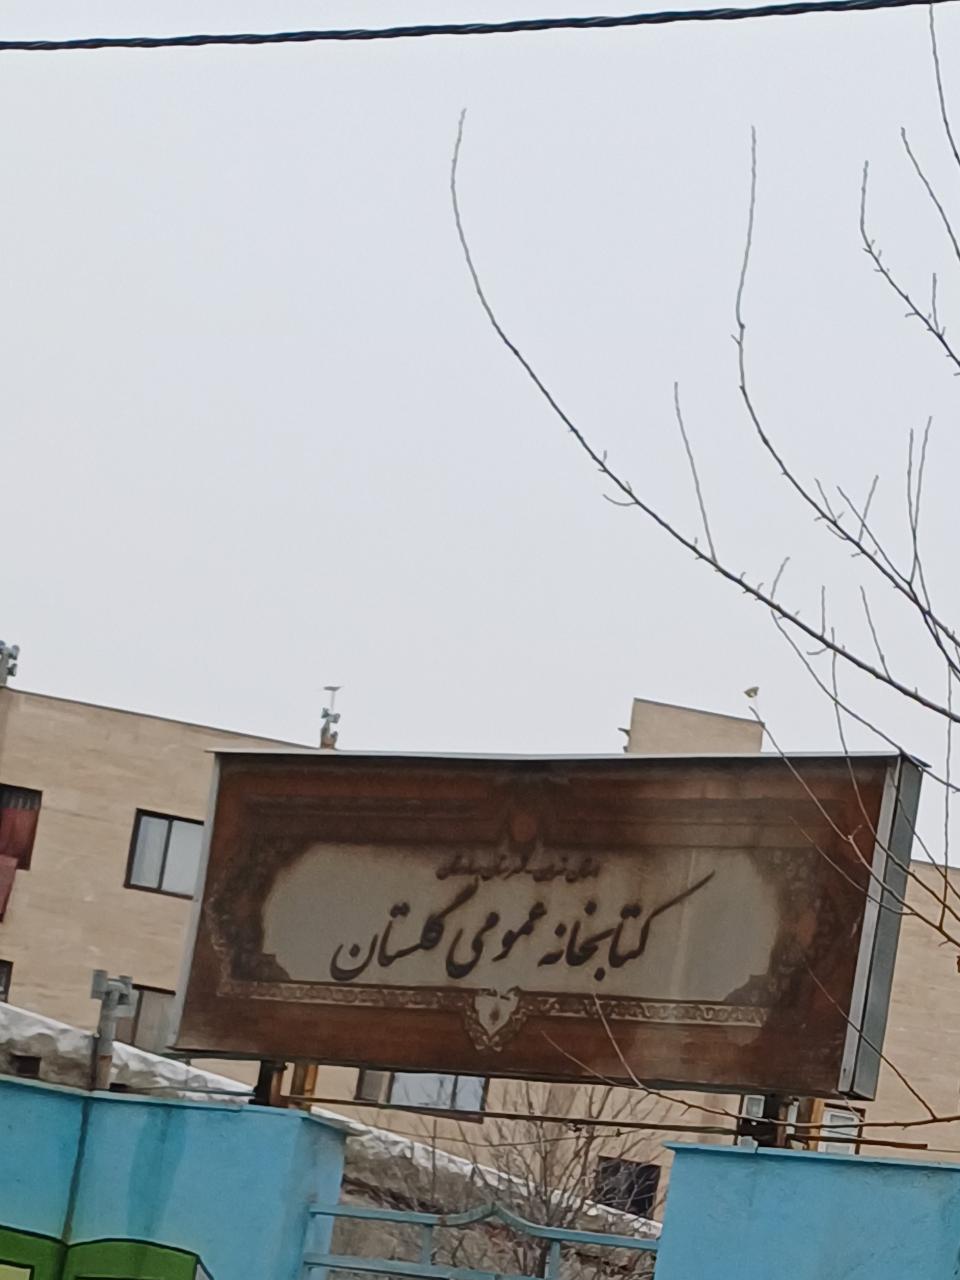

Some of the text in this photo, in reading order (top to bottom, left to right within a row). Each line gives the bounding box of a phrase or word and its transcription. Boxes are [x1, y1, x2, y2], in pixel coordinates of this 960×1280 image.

[329, 872, 716, 981] کتابخانه عمومی گلستان
